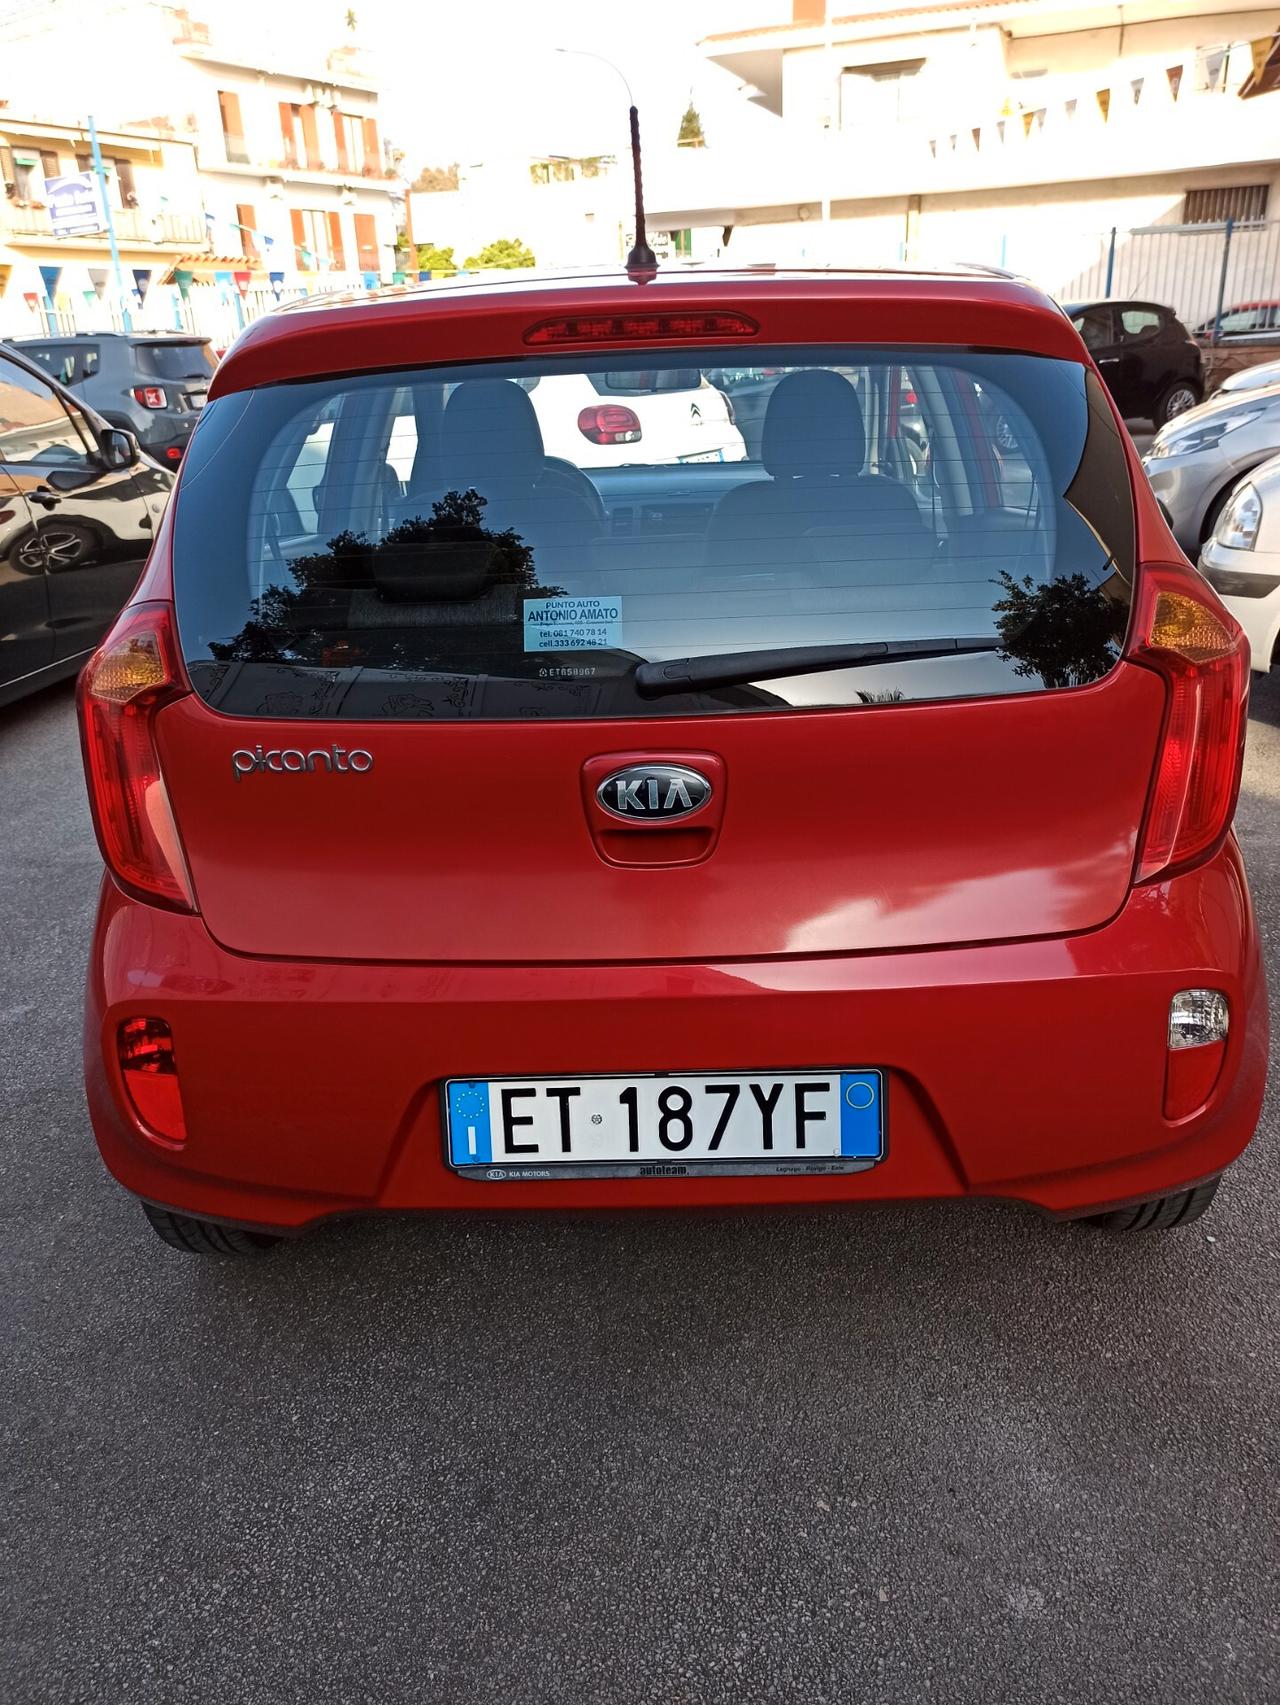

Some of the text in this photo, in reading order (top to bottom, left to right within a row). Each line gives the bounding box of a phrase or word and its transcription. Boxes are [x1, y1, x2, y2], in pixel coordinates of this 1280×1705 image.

[528, 608, 618, 621] ANTONIO AMATO
[546, 600, 600, 609] PUNTO AUTO
[570, 638, 586, 647] 692
[232, 744, 374, 782] picanto
[615, 777, 694, 810] KIA
[501, 1087, 582, 1155] ET
[618, 1082, 831, 1153] 187YF
